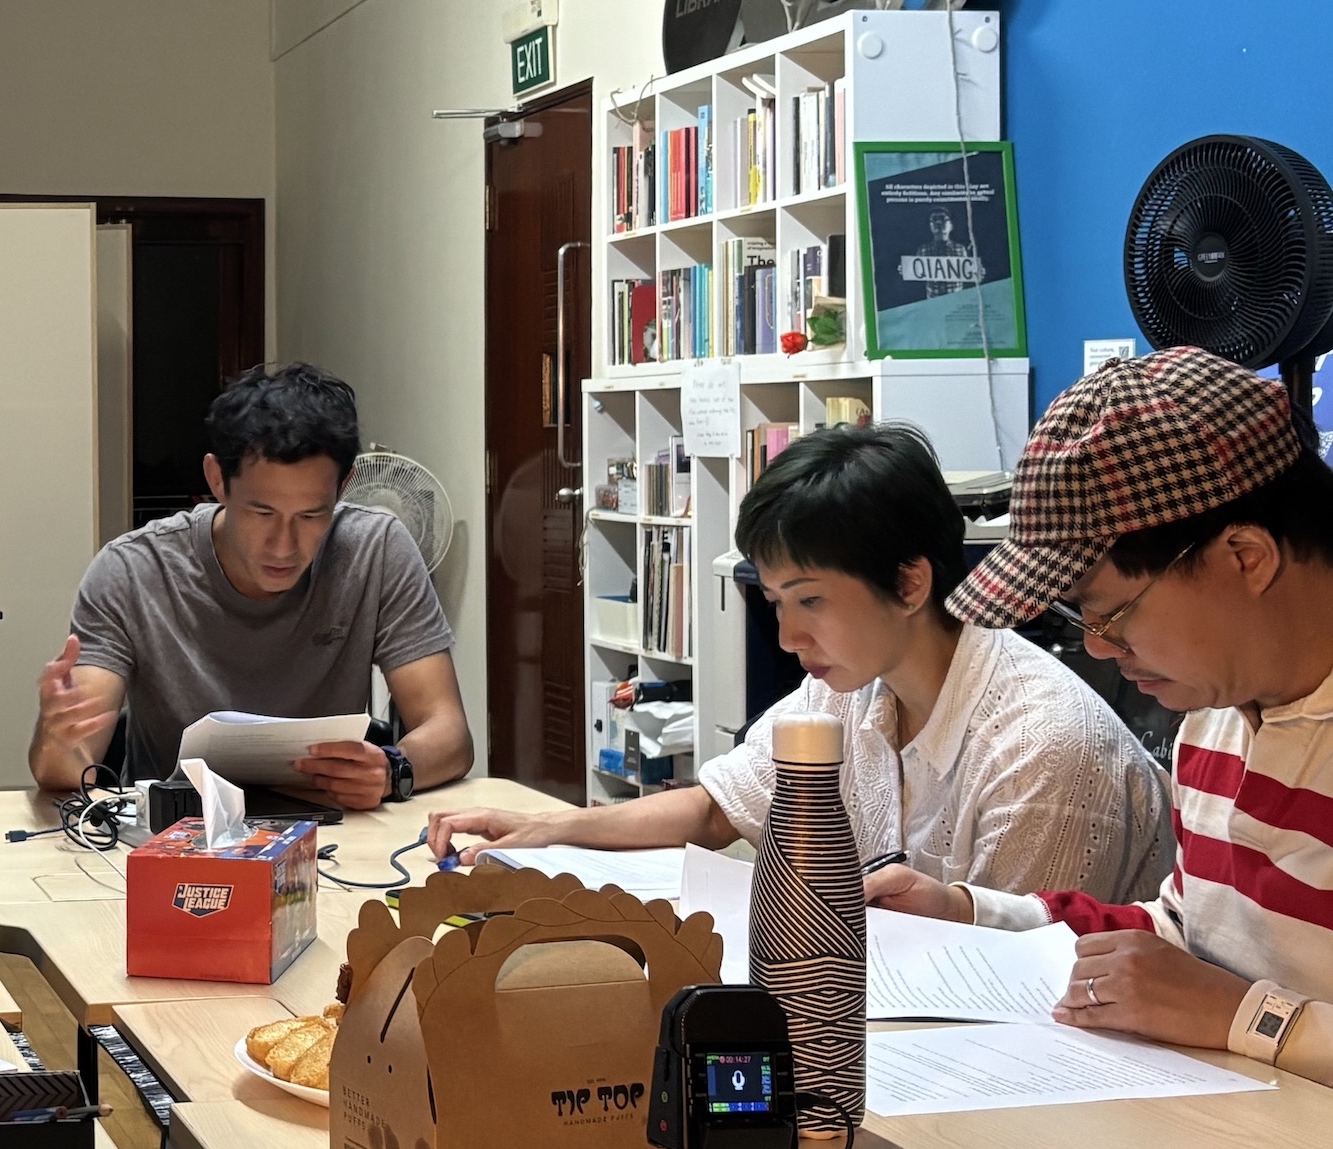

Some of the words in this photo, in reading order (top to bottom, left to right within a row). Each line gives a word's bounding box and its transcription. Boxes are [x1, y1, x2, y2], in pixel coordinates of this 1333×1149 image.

[516, 37, 543, 83] EXIT
[912, 258, 978, 280] QIANG
[176, 884, 230, 899] JUSTICE
[182, 897, 227, 912] LEAGUE
[342, 1085, 370, 1107] BETTER
[551, 1088, 591, 1117] TIP
[597, 1083, 645, 1112] TOP
[343, 1100, 387, 1129] HANDMADE
[563, 1116, 608, 1126] HANDMADE
[610, 1113, 635, 1122] PUFFS
